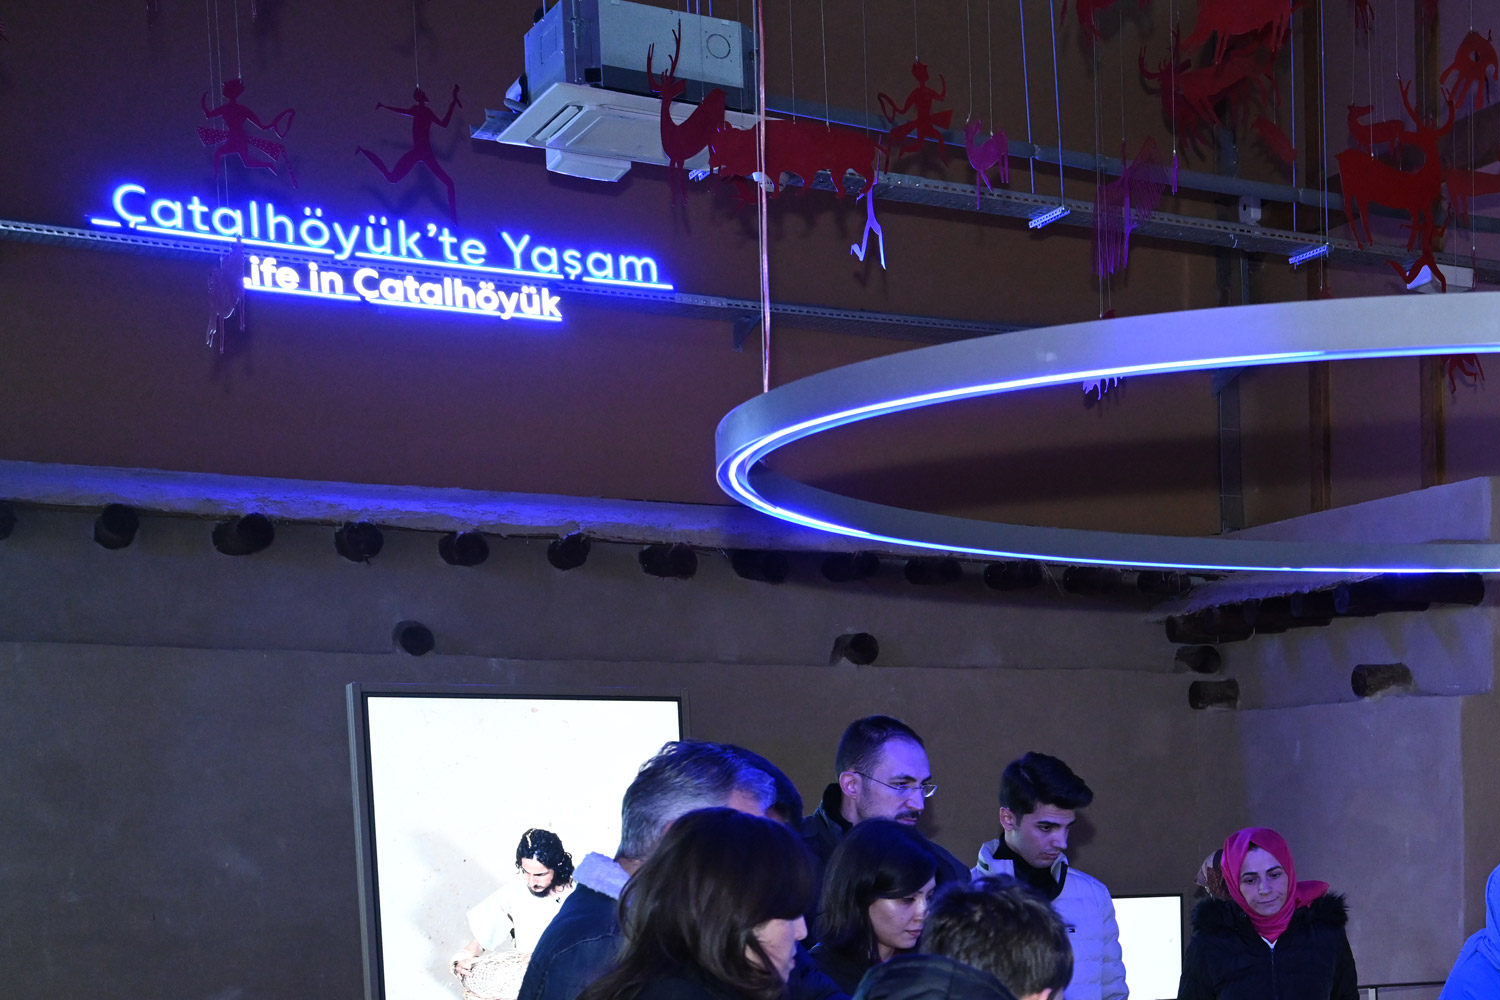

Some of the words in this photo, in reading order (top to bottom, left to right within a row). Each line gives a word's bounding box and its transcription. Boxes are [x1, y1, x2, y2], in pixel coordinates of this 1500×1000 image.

[243, 255, 300, 291] ife
[308, 262, 344, 295] in
[501, 231, 658, 282] Yaşam
